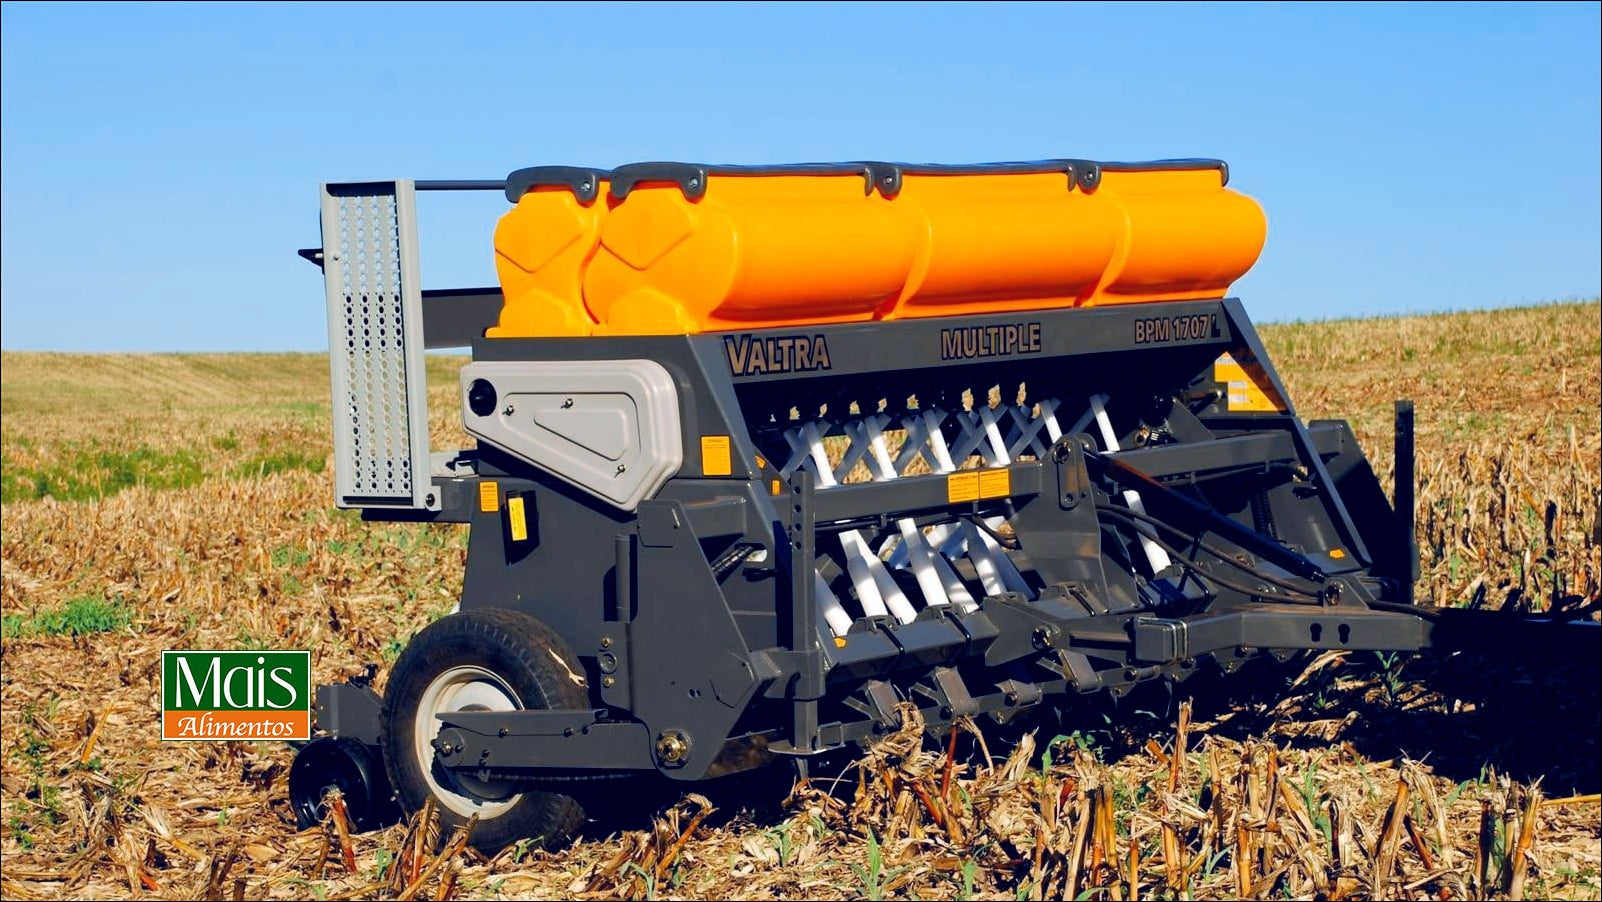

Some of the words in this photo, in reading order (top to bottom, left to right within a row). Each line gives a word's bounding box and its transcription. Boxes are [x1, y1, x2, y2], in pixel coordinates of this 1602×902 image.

[941, 323, 1041, 360] MULTIPLE
[1135, 317, 1170, 344] BPM
[1172, 314, 1209, 340] 1707
[723, 334, 832, 377] VALTRA
